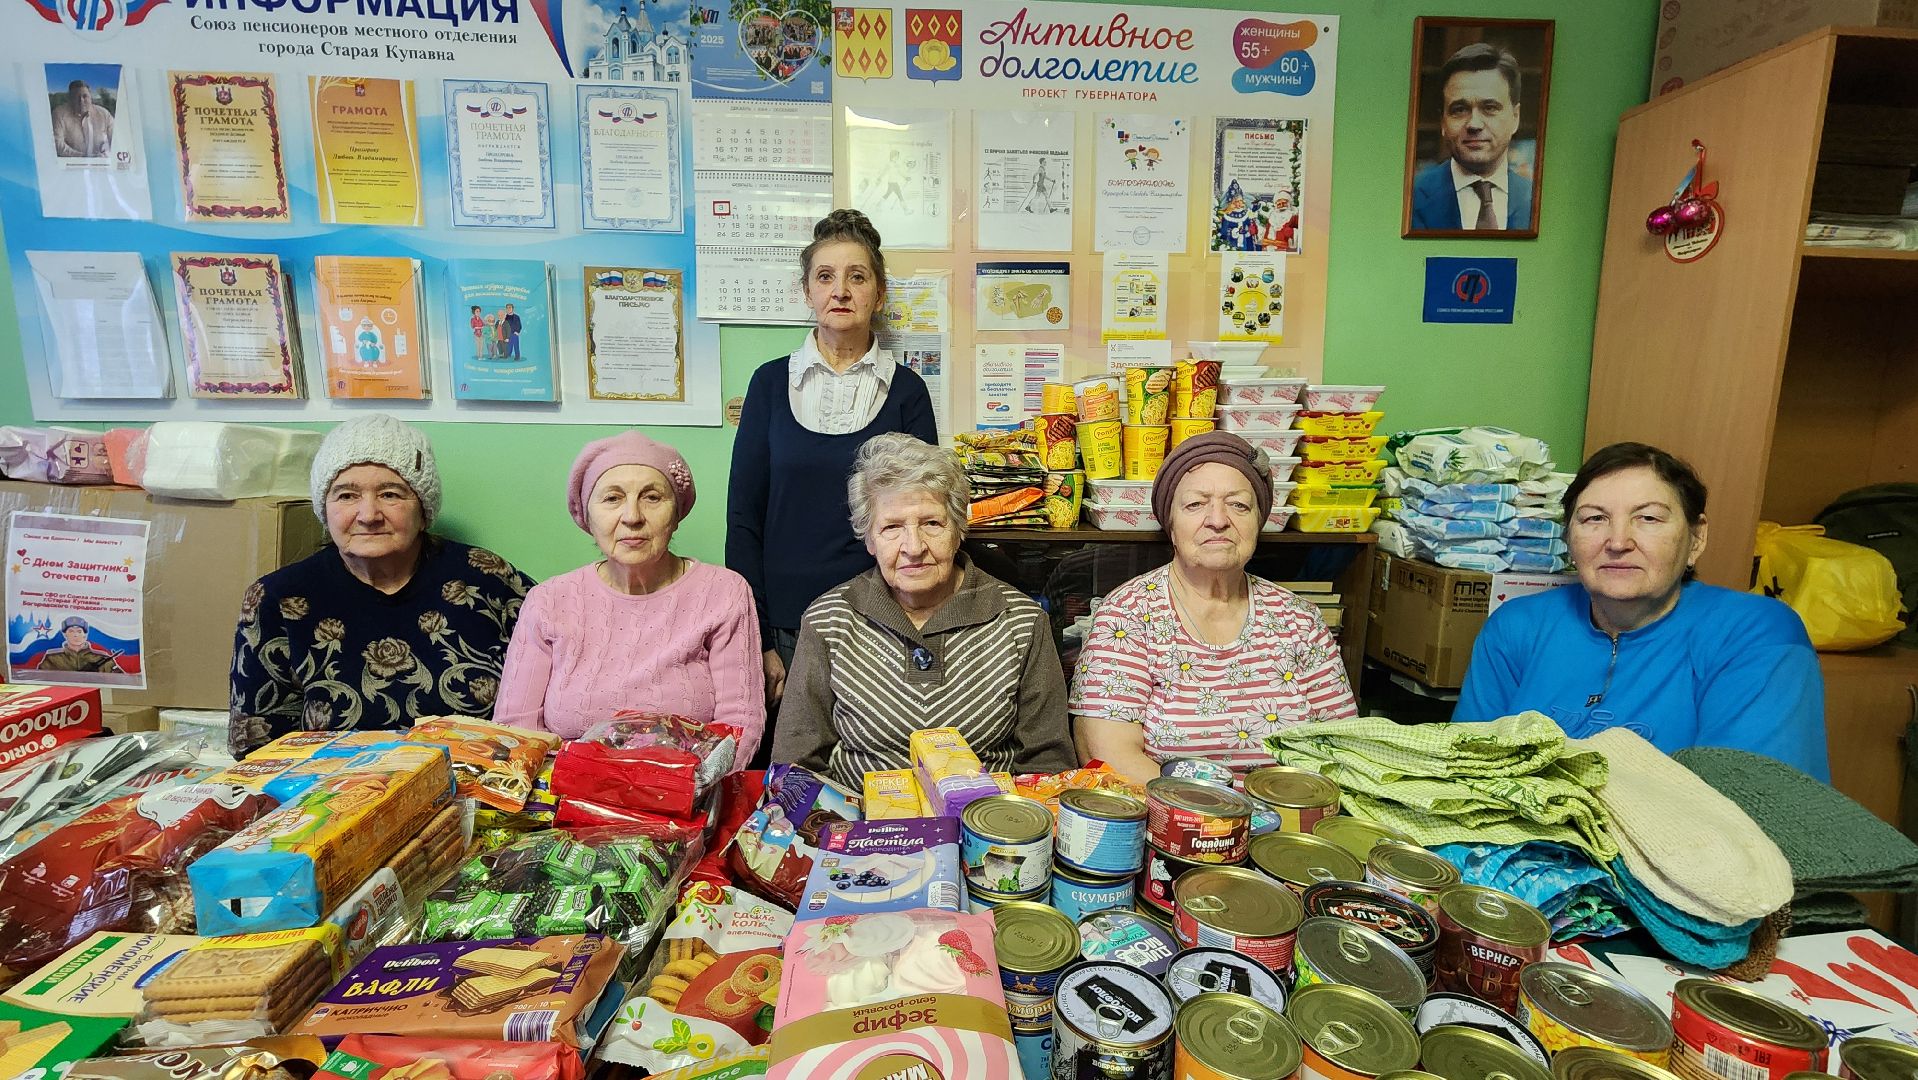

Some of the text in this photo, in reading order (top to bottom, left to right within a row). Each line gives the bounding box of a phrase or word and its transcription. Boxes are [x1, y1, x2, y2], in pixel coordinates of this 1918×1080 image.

[190, 15, 517, 44] Союз пенсионеров местного отделения
[980, 7, 1195, 51] Активное
[1240, 27, 1301, 39] женщины
[700, 34, 725, 44] 2025
[258, 41, 455, 62] города Старая Купавна
[1241, 41, 1271, 59] 55+
[980, 42, 1199, 85] долголетие
[1280, 57, 1310, 74] 60+
[1245, 74, 1302, 87] мужчины
[1022, 87, 1158, 103] ПРОЕКТ ГУБЕРНАТОРА
[194, 106, 258, 118] ПОЧЕТНАЯ
[332, 105, 388, 117] ГРАМОТА
[200, 116, 254, 127] ГРАМОТА
[470, 122, 526, 133] ПОЧЕТНАЯ
[475, 131, 522, 141] ГРАМОТА
[199, 288, 263, 297] ПОЧЕТНАЯ
[206, 297, 258, 306] ГРАМОТА
[22, 557, 129, 573] С Днем Защитника
[41, 570, 108, 583] Отечества !
[0, 699, 90, 743] Choco
[848, 835, 925, 849] Пастила
[1191, 837, 1236, 849] Говядина
[383, 956, 441, 969] Delibon
[1471, 945, 1518, 968] ВЕРНЕР
[68, 934, 158, 1004] КОЛОМЕНСКИЕ
[342, 976, 441, 998] ВАФЛИ
[852, 996, 937, 1019] бело-розовый
[853, 1008, 938, 1034] Зефир
